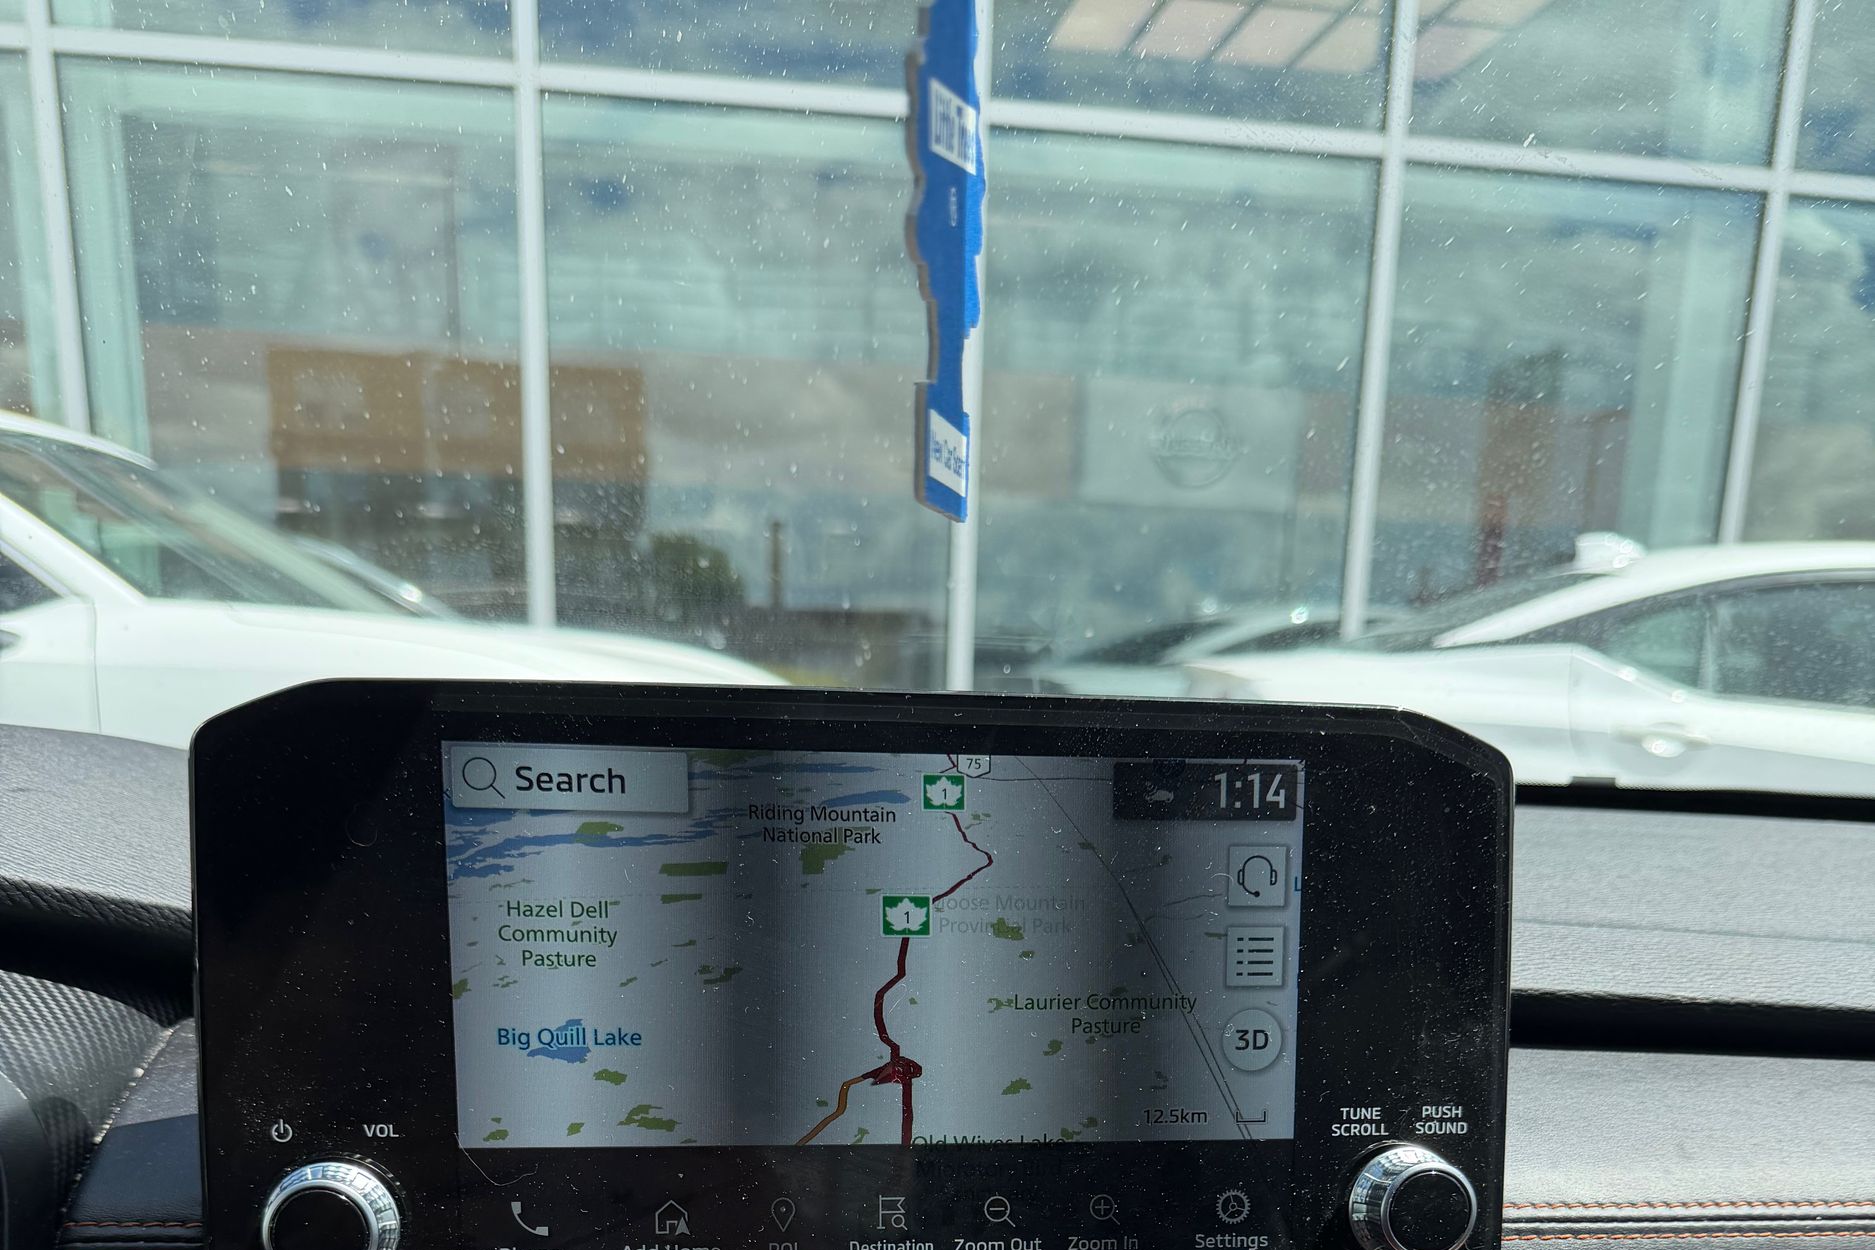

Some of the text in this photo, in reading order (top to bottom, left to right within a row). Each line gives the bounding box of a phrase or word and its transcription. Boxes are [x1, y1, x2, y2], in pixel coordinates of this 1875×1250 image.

[966, 758, 982, 770] 75
[515, 766, 626, 794] Search
[941, 787, 948, 801] 1
[1214, 772, 1287, 810] 1:14
[748, 804, 897, 824] Riding Mountain
[763, 827, 881, 845] National Park
[506, 900, 610, 919] Hazel Dell
[935, 894, 1085, 912] oose Mountain
[903, 911, 910, 926] 1
[1033, 918, 1072, 935] Park
[498, 925, 618, 947] Community
[522, 950, 597, 968] Pasture
[1013, 994, 1197, 1015] Laurier Community
[1071, 1018, 1141, 1035] Pasture
[498, 1027, 642, 1048] Big Quill Lake
[1234, 1030, 1270, 1052] 3D
[1142, 1108, 1208, 1126] 12.5km
[1340, 1107, 1381, 1120] TUNE
[1422, 1106, 1462, 1118] PUSH
[363, 1124, 400, 1138] VOL
[1331, 1123, 1389, 1137] SCROLL
[1415, 1122, 1467, 1135] SOUND
[1067, 1236, 1139, 1250] Zoom In
[1195, 1233, 1269, 1250] Settings
